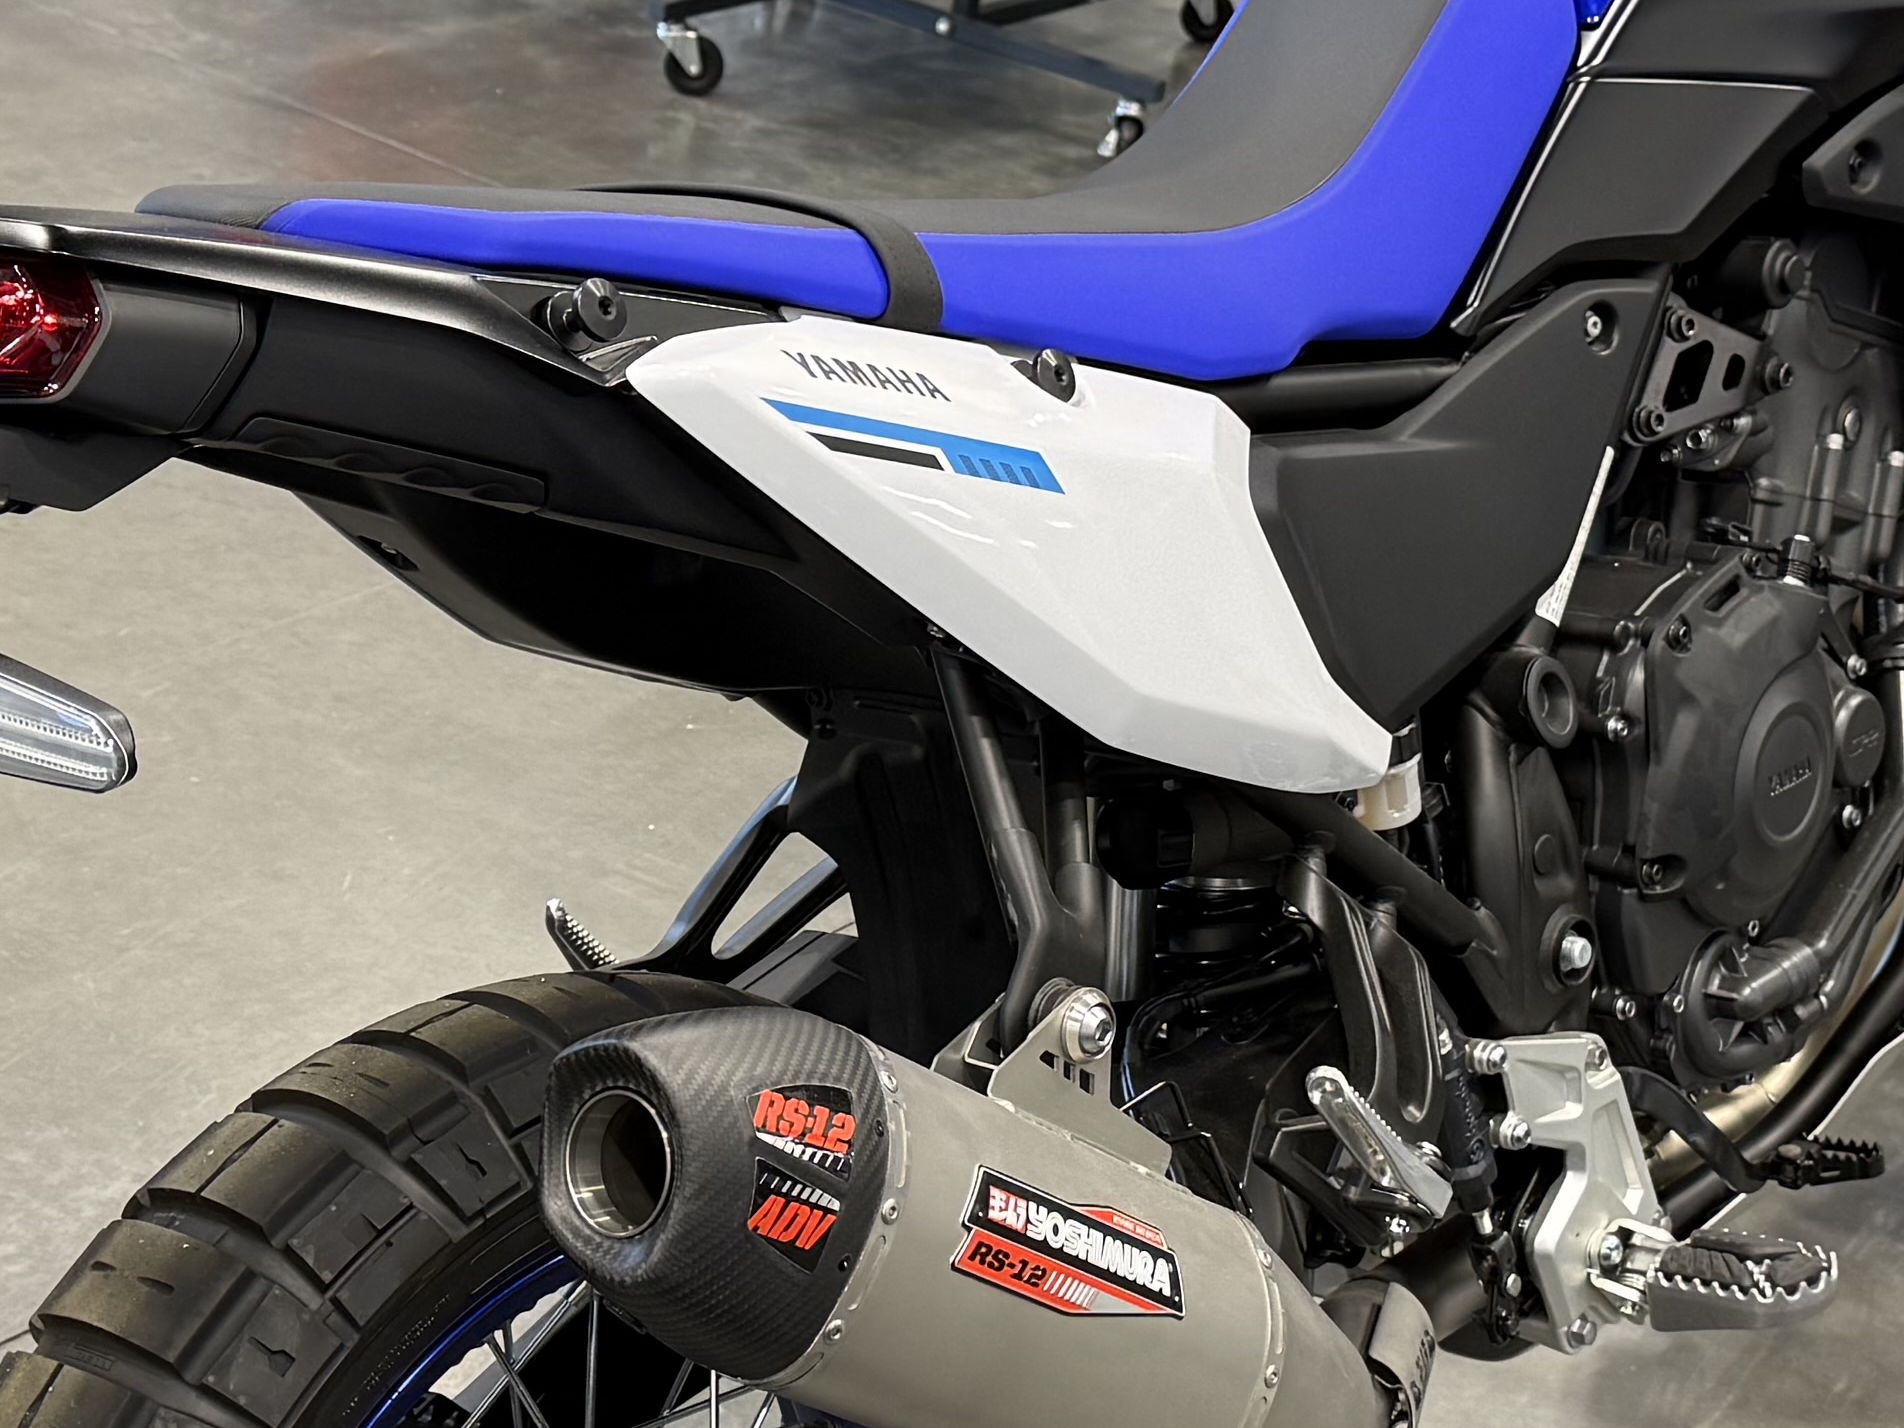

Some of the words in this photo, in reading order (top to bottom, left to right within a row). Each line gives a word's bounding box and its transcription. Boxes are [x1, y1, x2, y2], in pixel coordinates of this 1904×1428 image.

[782, 347, 953, 404] YAMAHA
[753, 1089, 856, 1154] RS-12
[748, 1194, 837, 1250] ADV
[1026, 1200, 1173, 1297] YOSHIMURA
[968, 1240, 1048, 1289] RS-12
